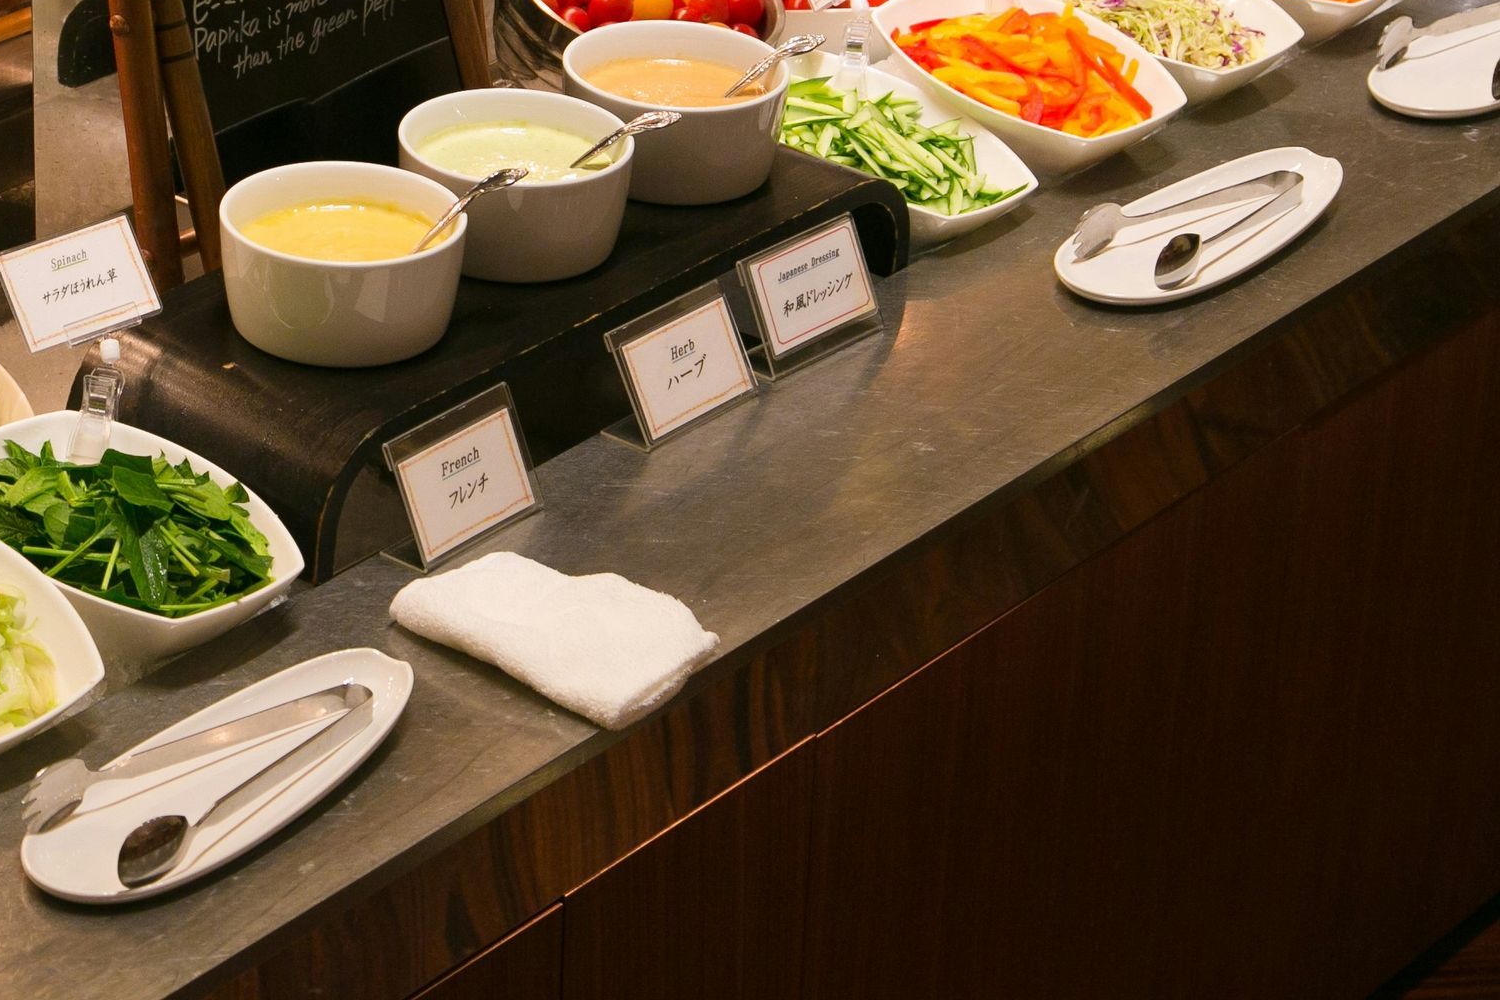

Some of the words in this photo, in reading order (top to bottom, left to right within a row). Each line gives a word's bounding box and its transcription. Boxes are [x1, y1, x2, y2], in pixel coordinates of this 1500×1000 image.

[194, 10, 261, 63] Paprika
[268, 7, 281, 29] is
[233, 46, 273, 79] than
[277, 24, 305, 60] the
[309, 7, 357, 54] green
[51, 249, 87, 270] Spinach
[778, 262, 808, 282] Japanese
[811, 248, 840, 268] Dressing
[42, 267, 118, 304] サラダほうれん草
[670, 339, 695, 361] Herb
[668, 353, 707, 390] ハーブ
[441, 446, 480, 477] French
[449, 472, 489, 509] フレンチ
